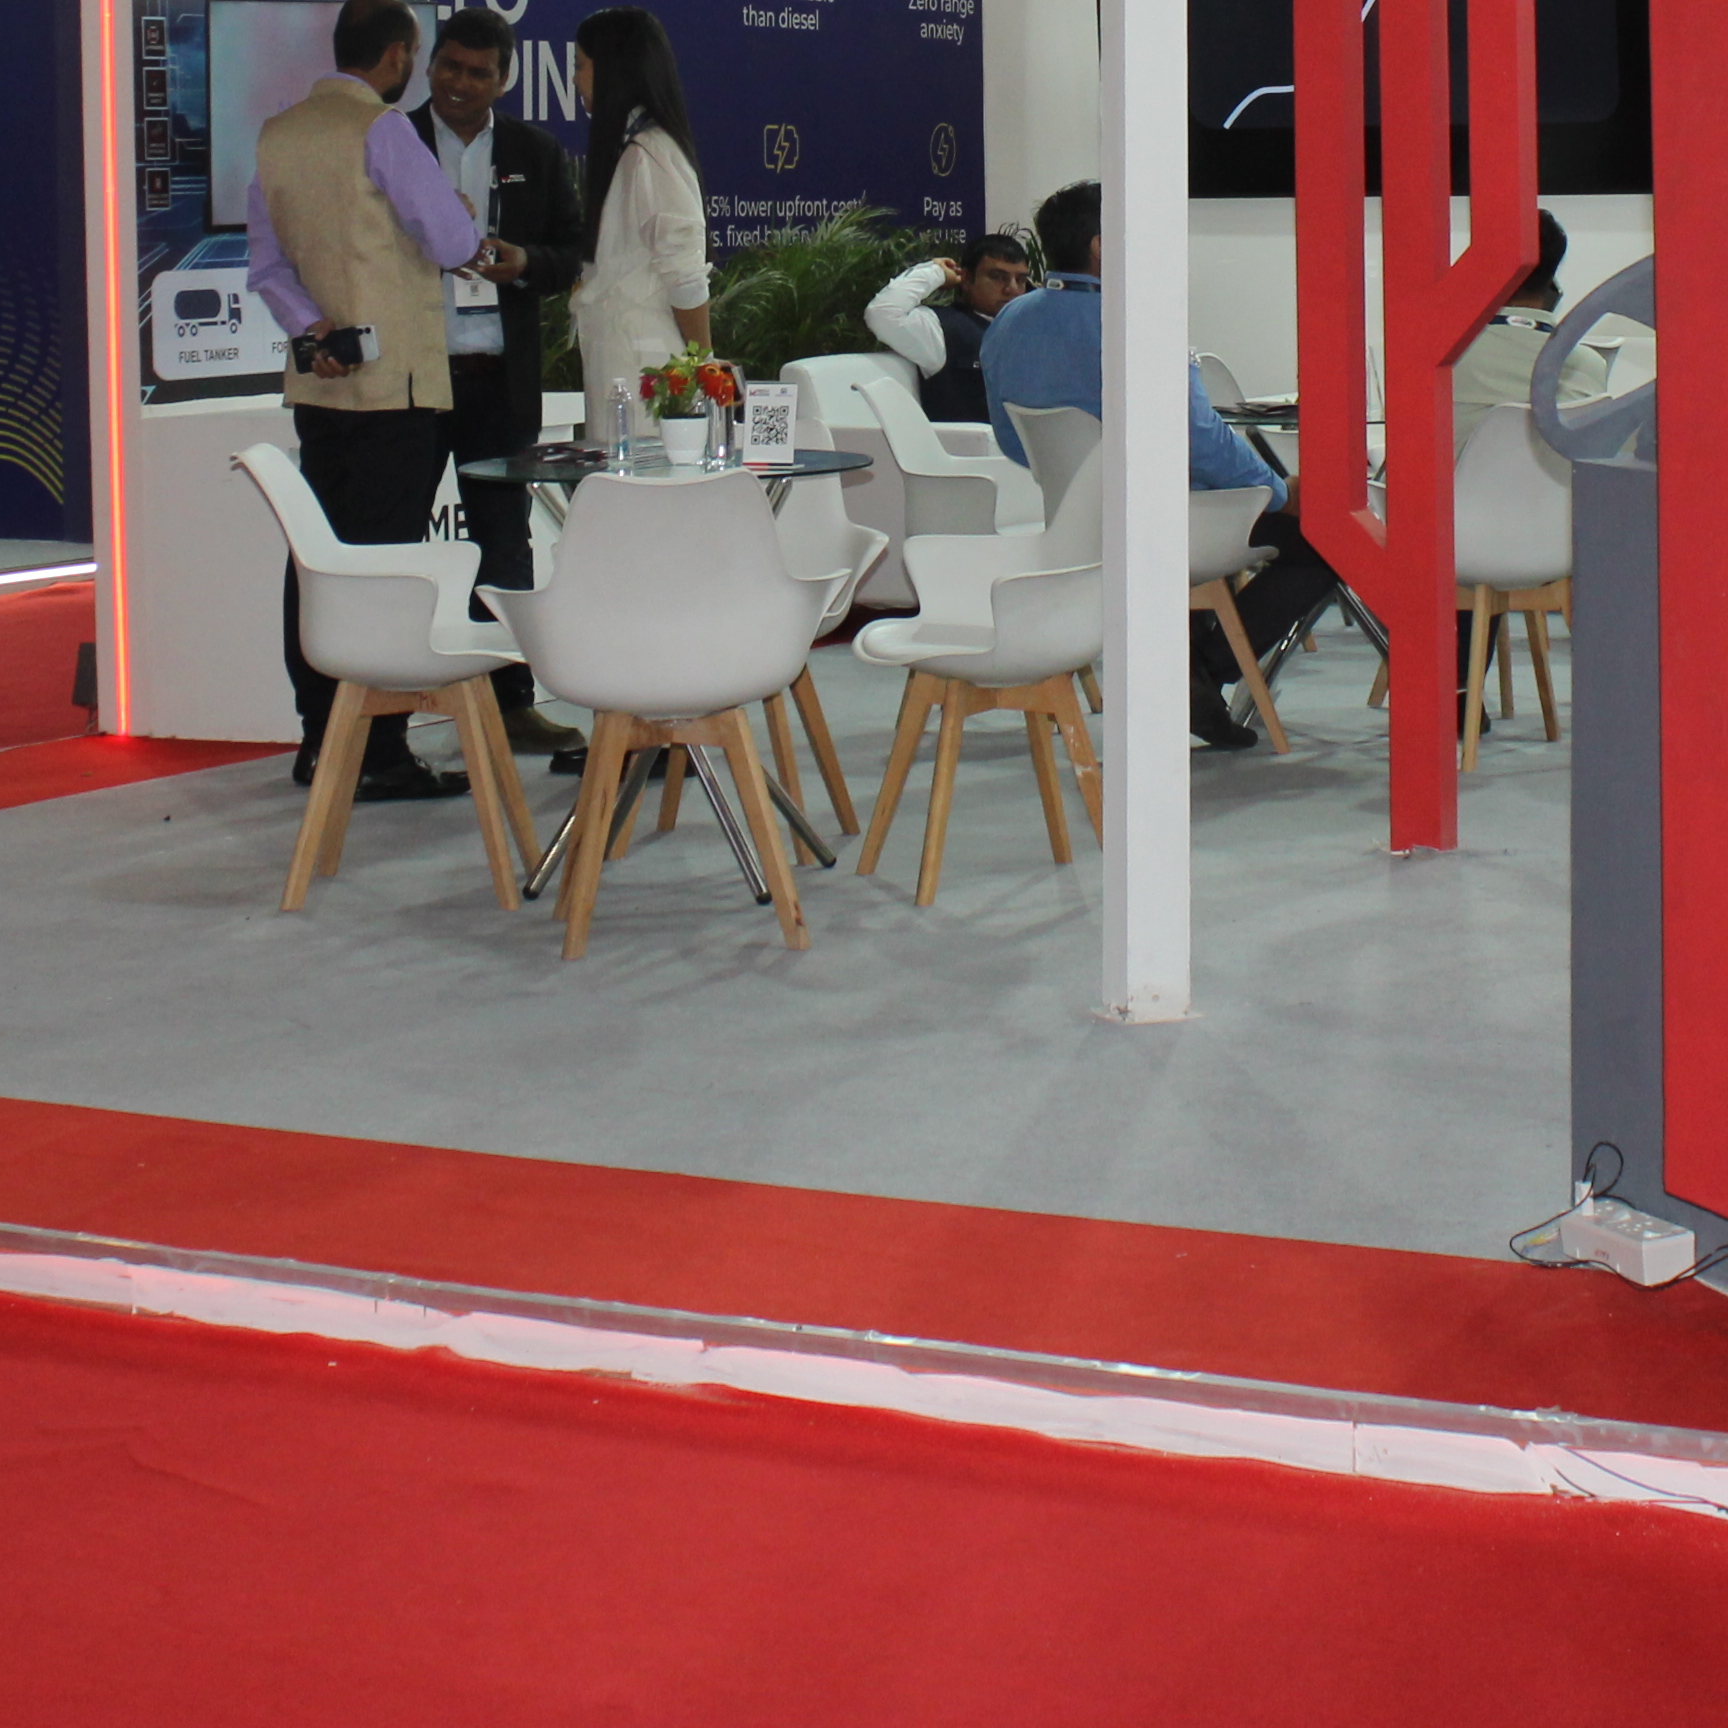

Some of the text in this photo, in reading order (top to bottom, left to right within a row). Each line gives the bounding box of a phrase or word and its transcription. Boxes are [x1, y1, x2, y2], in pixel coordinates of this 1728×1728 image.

[742, 4, 819, 31] than diesel
[920, 19, 965, 46] anxiety
[734, 195, 772, 217] lower
[777, 195, 828, 221] upfront
[923, 196, 963, 222] Pay as
[727, 224, 761, 247] fixed
[178, 347, 240, 364] FUEL TANKER
